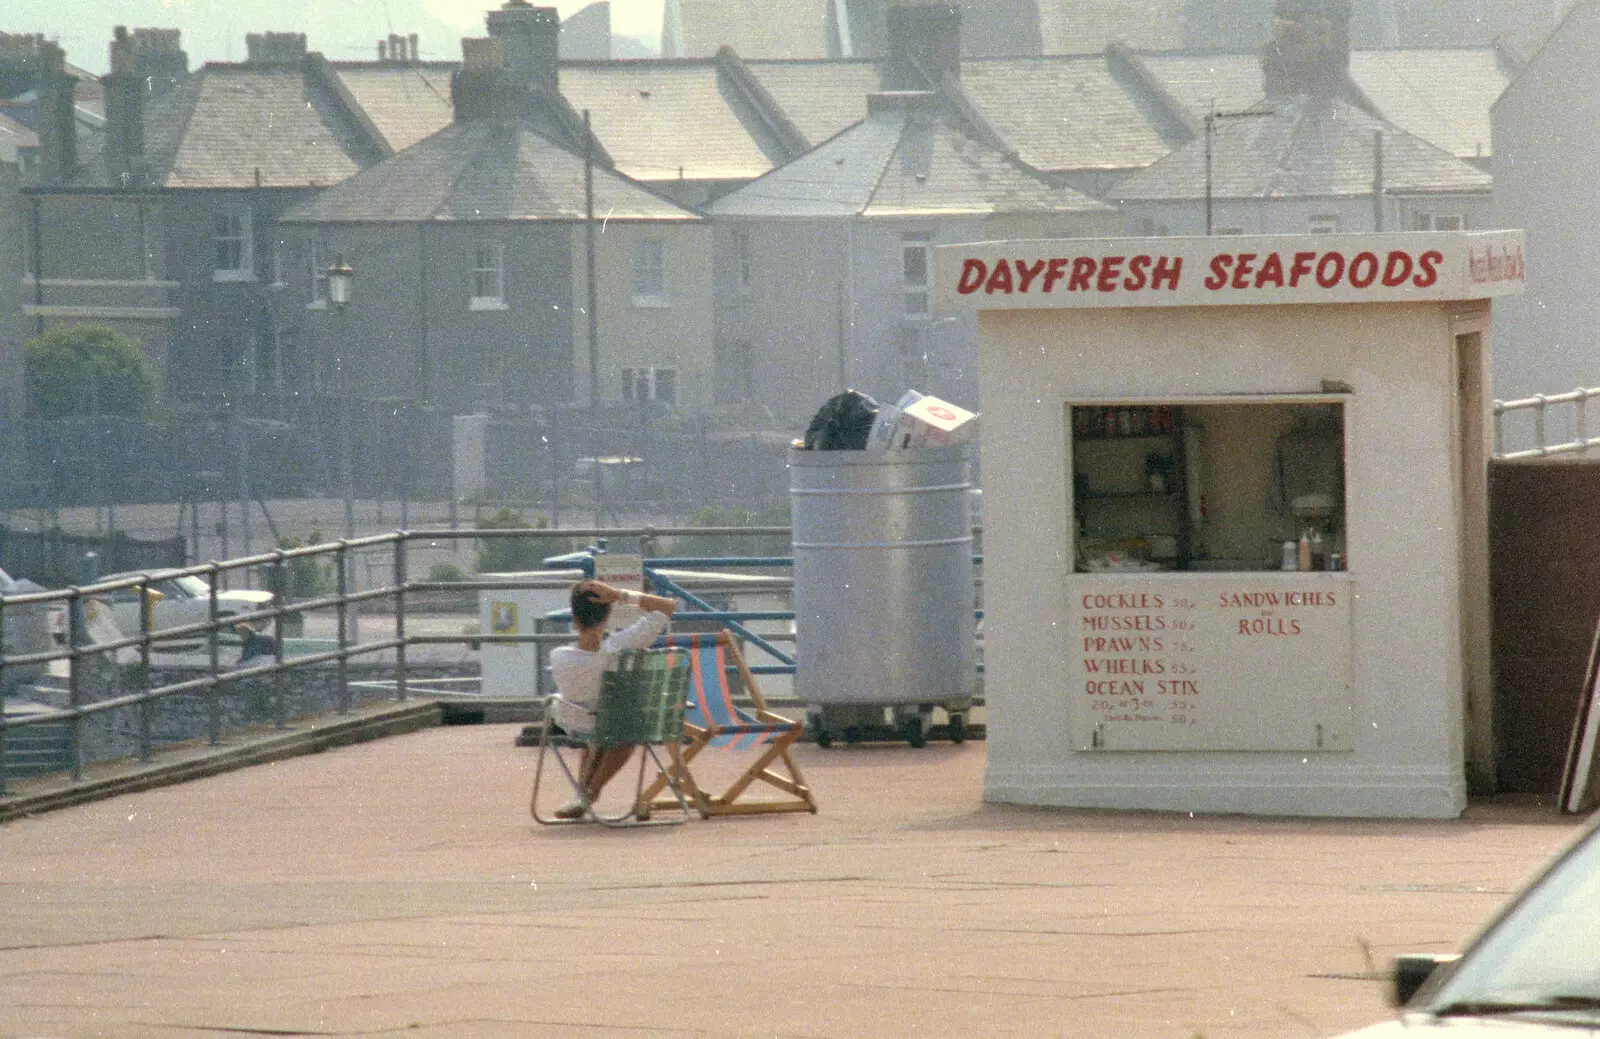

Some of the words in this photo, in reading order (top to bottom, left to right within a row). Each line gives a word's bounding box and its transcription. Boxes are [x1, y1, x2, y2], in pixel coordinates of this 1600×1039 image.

[957, 255, 1183, 295] DAYFRESH
[1204, 251, 1444, 290] SEAFOODS
[1082, 594, 1164, 609] COCKLES
[1219, 592, 1336, 607] SANDWICHES
[1083, 615, 1165, 631] MUSSELS
[1239, 618, 1301, 636] ROLLS
[1084, 636, 1164, 652] PRAWNS
[1083, 658, 1165, 675] WHELKS
[1085, 680, 1144, 695] OCEAN
[1157, 679, 1200, 695] STIX
